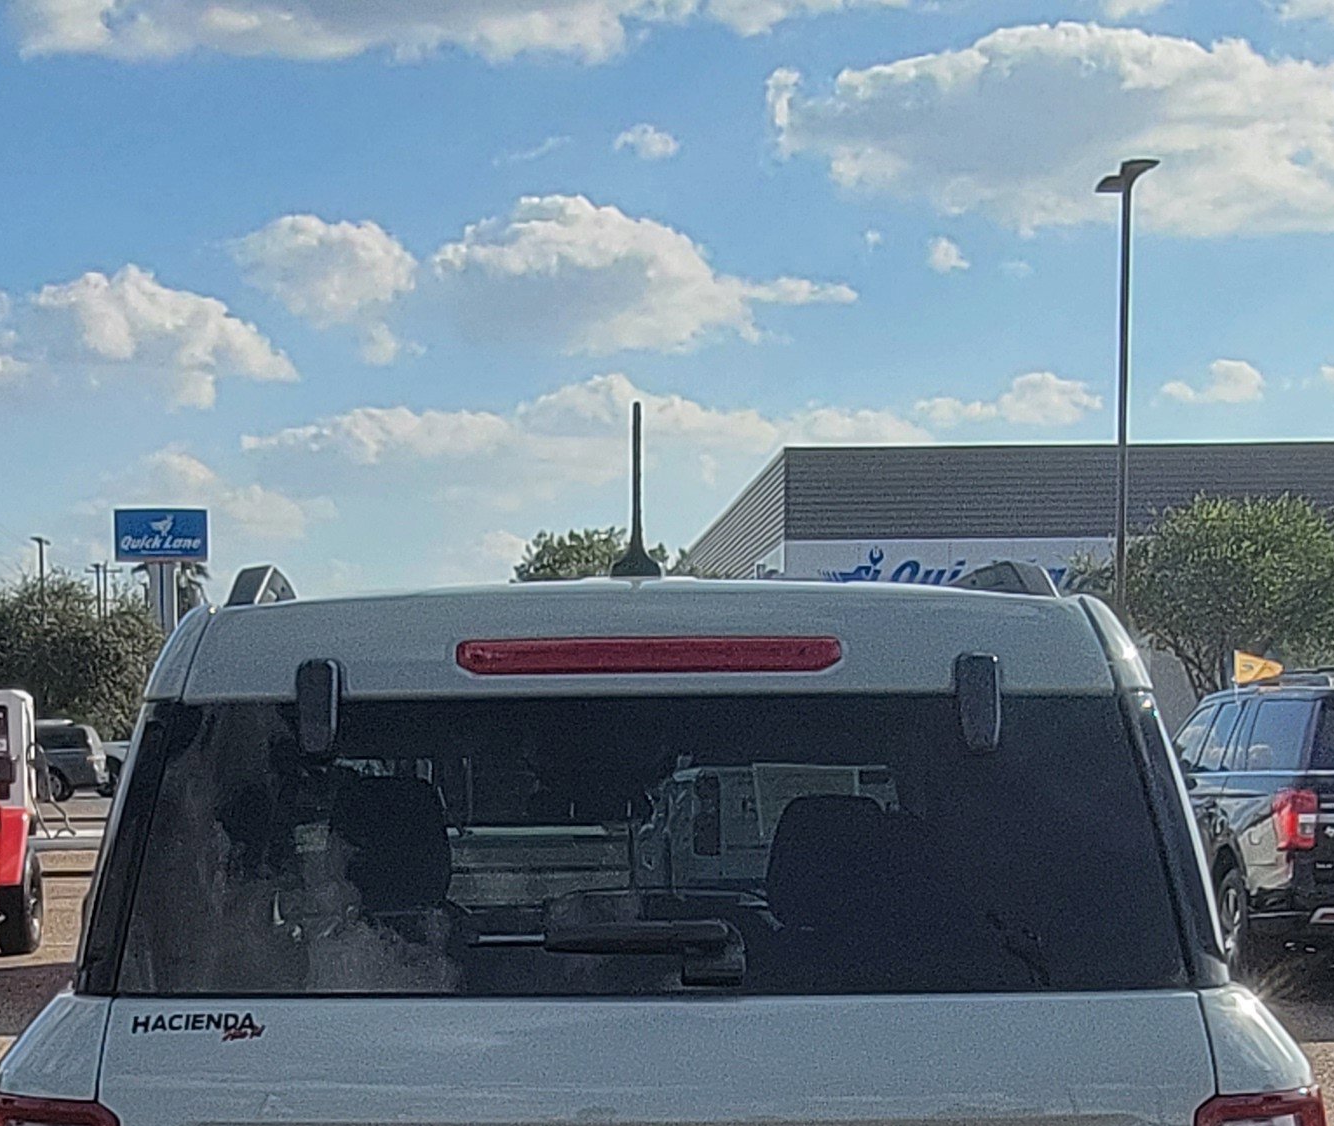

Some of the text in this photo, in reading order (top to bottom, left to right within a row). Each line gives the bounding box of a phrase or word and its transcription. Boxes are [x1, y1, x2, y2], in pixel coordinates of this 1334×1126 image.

[121, 535, 201, 551] Quick Lane
[132, 1013, 257, 1034] HACIENDA
